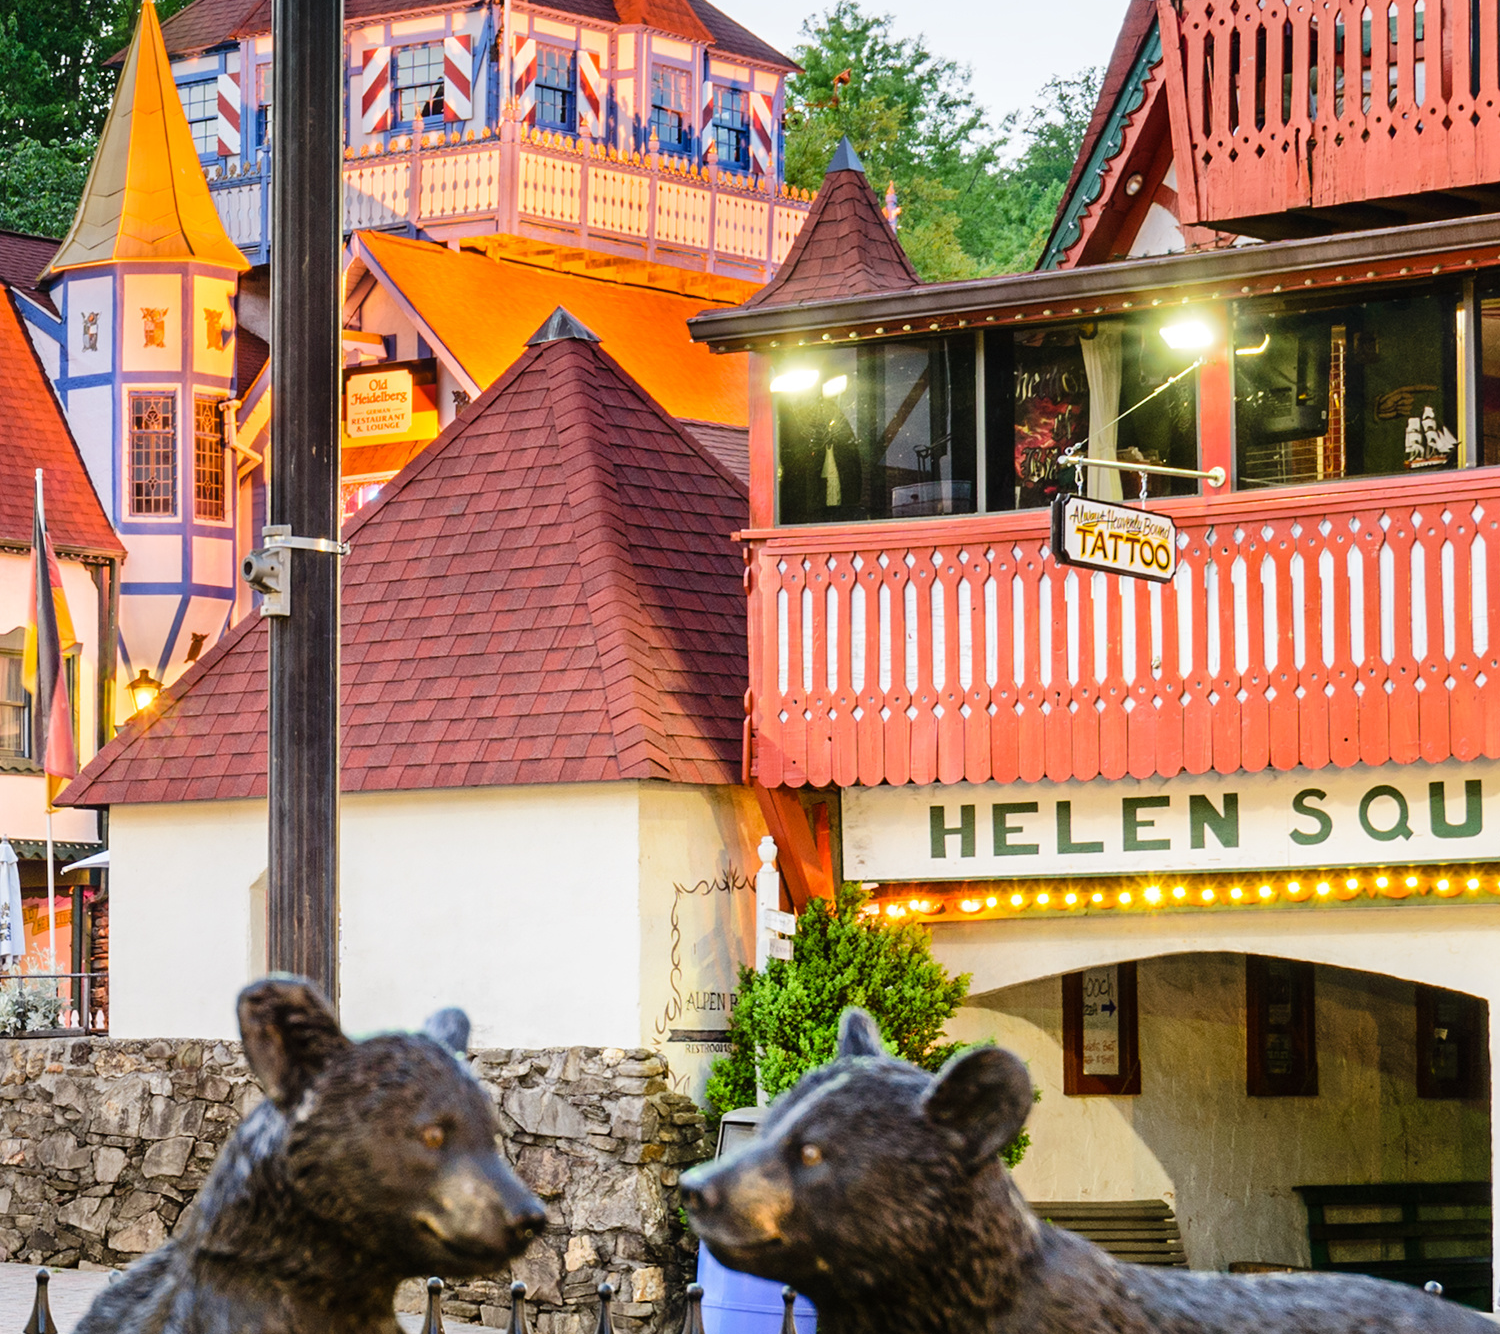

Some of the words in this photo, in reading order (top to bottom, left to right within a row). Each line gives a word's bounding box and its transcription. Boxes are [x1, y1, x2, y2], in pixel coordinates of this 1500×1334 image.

[369, 379, 388, 391] Old
[350, 392, 408, 406] Heidelberg
[351, 413, 406, 425] RESTAURANT
[366, 422, 400, 431] LOUNGE
[1106, 509, 1143, 533] Heavenly
[1143, 517, 1171, 540] Bound
[1075, 526, 1171, 572] TATTOO
[930, 793, 1239, 859] HELEN
[686, 992, 726, 1012] ALPEN
[685, 1043, 733, 1054] RESTROOMS
